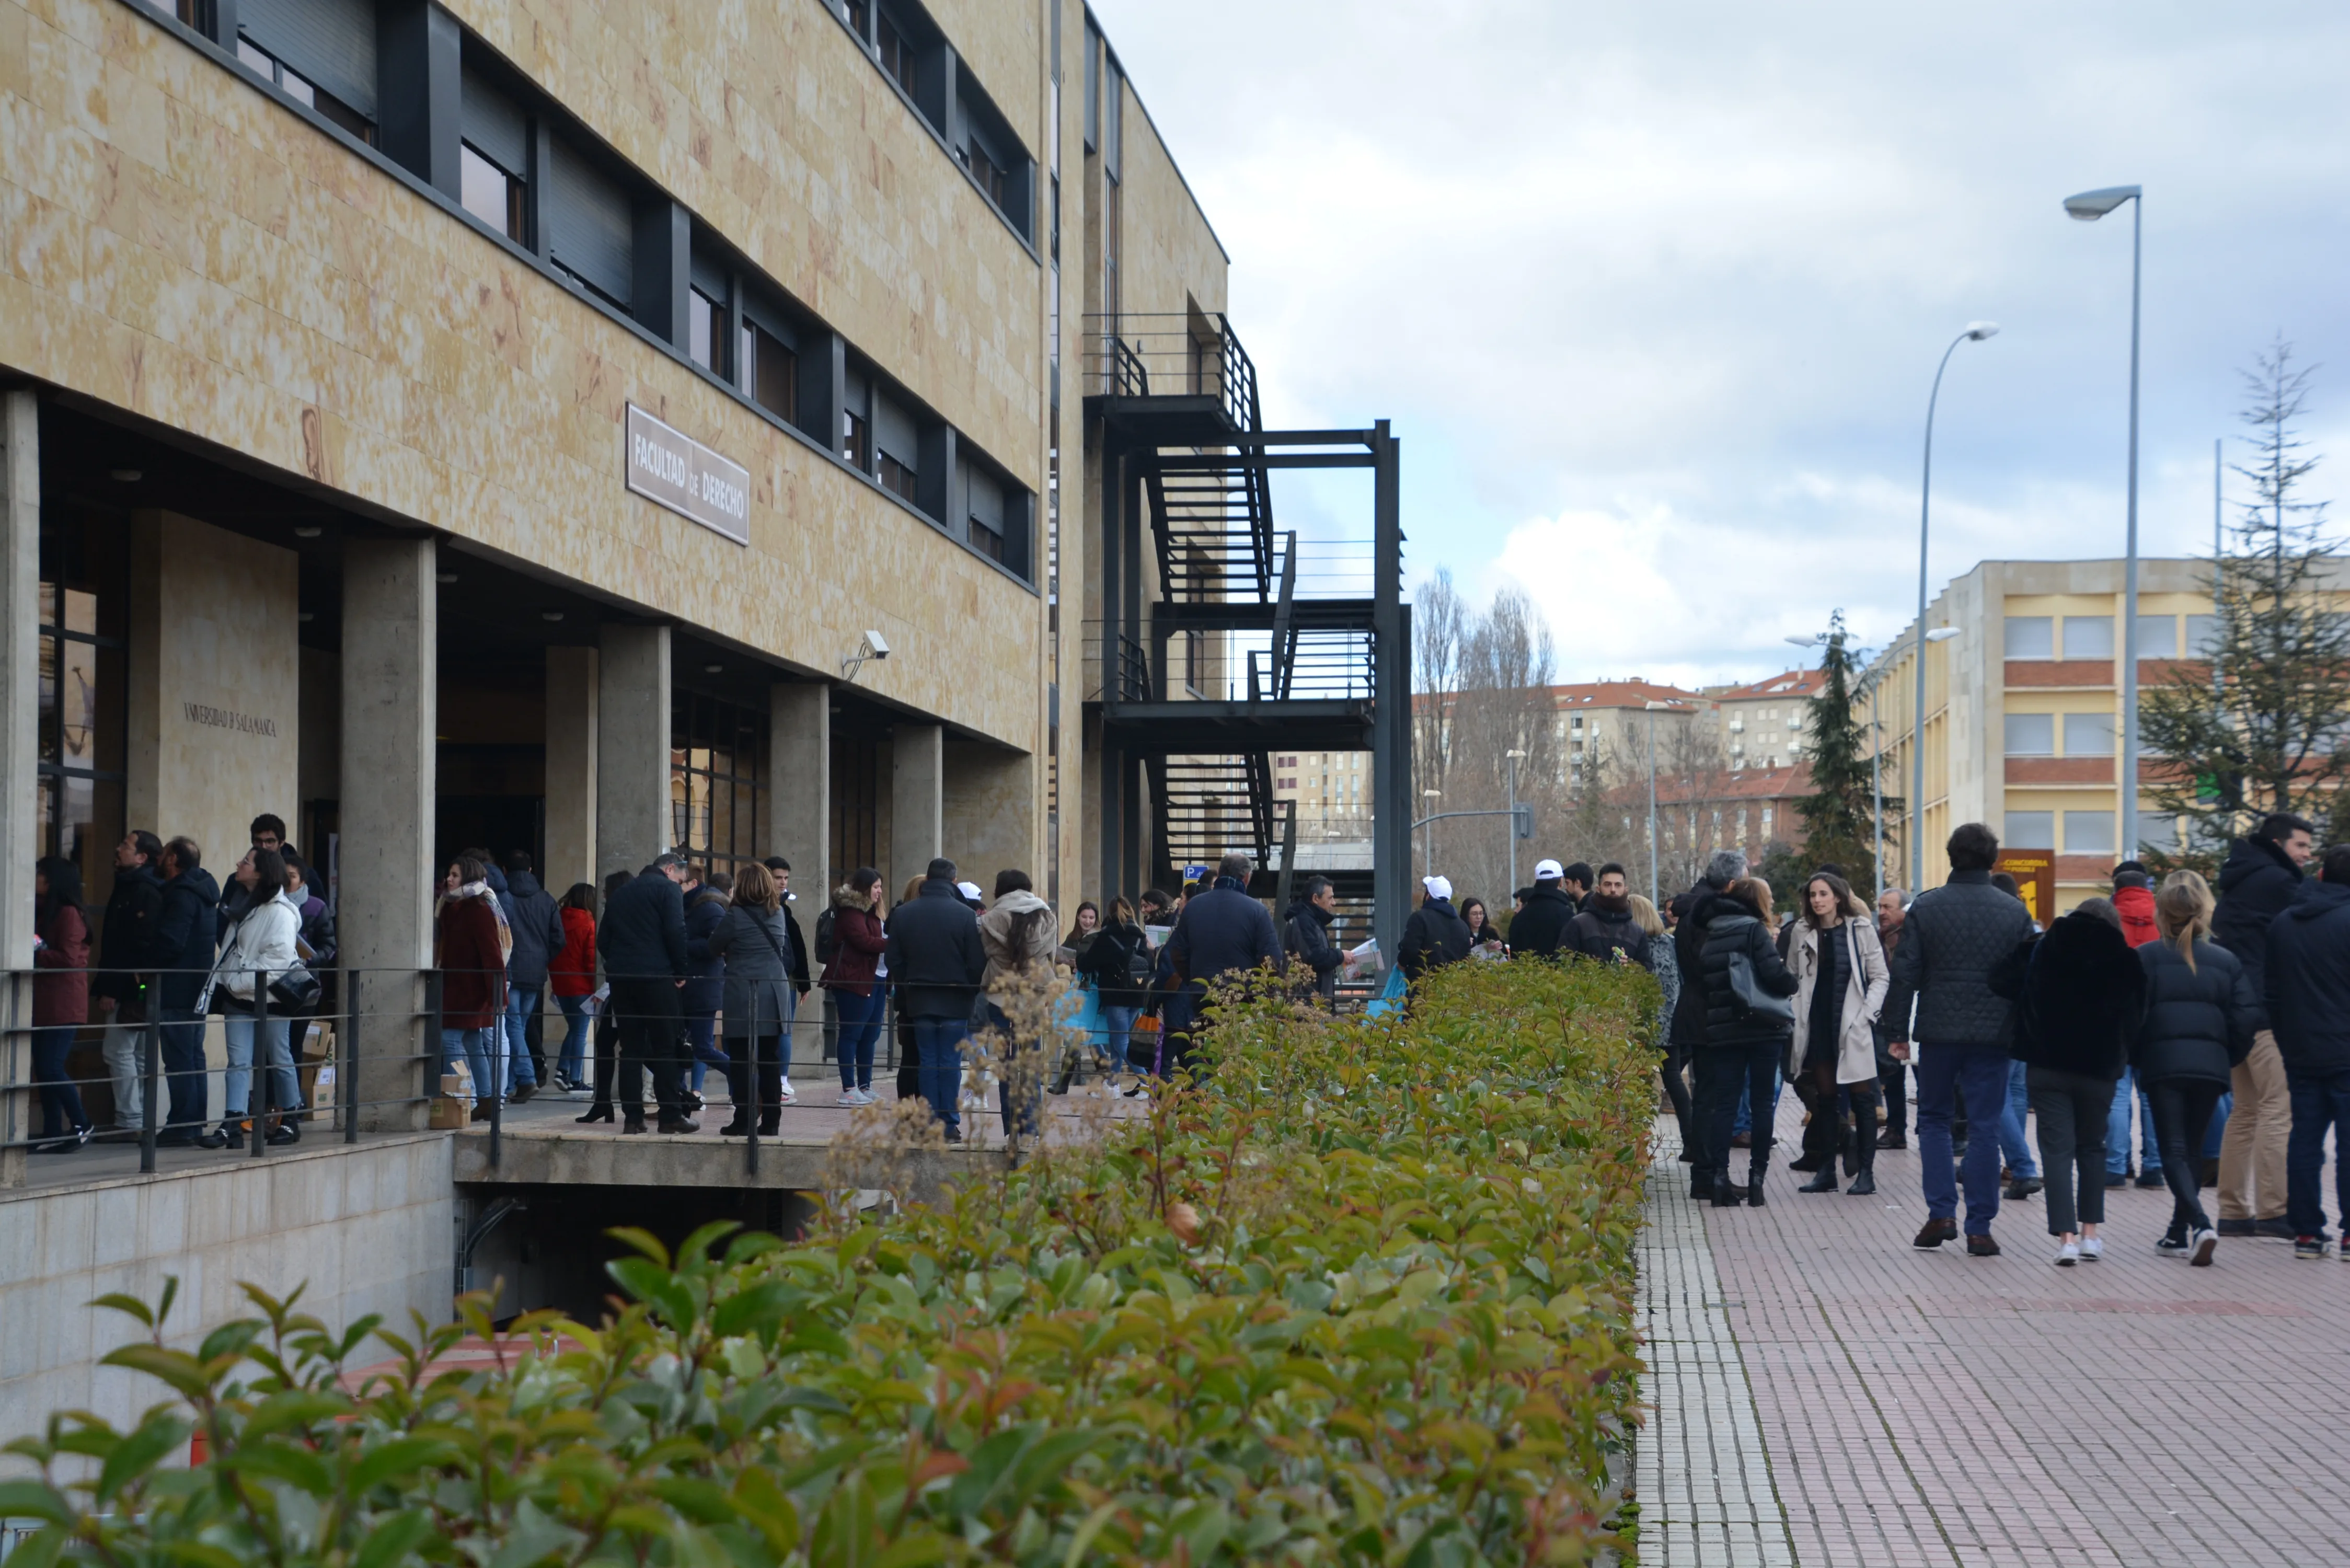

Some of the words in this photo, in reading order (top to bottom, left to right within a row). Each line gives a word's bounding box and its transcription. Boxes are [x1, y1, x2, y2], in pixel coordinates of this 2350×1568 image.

[635, 433, 685, 488] FACULTAD
[689, 471, 698, 497] DE
[702, 470, 743, 520] DERECHO
[236, 713, 276, 738] SALAMANCA
[1187, 867, 1195, 878] P
